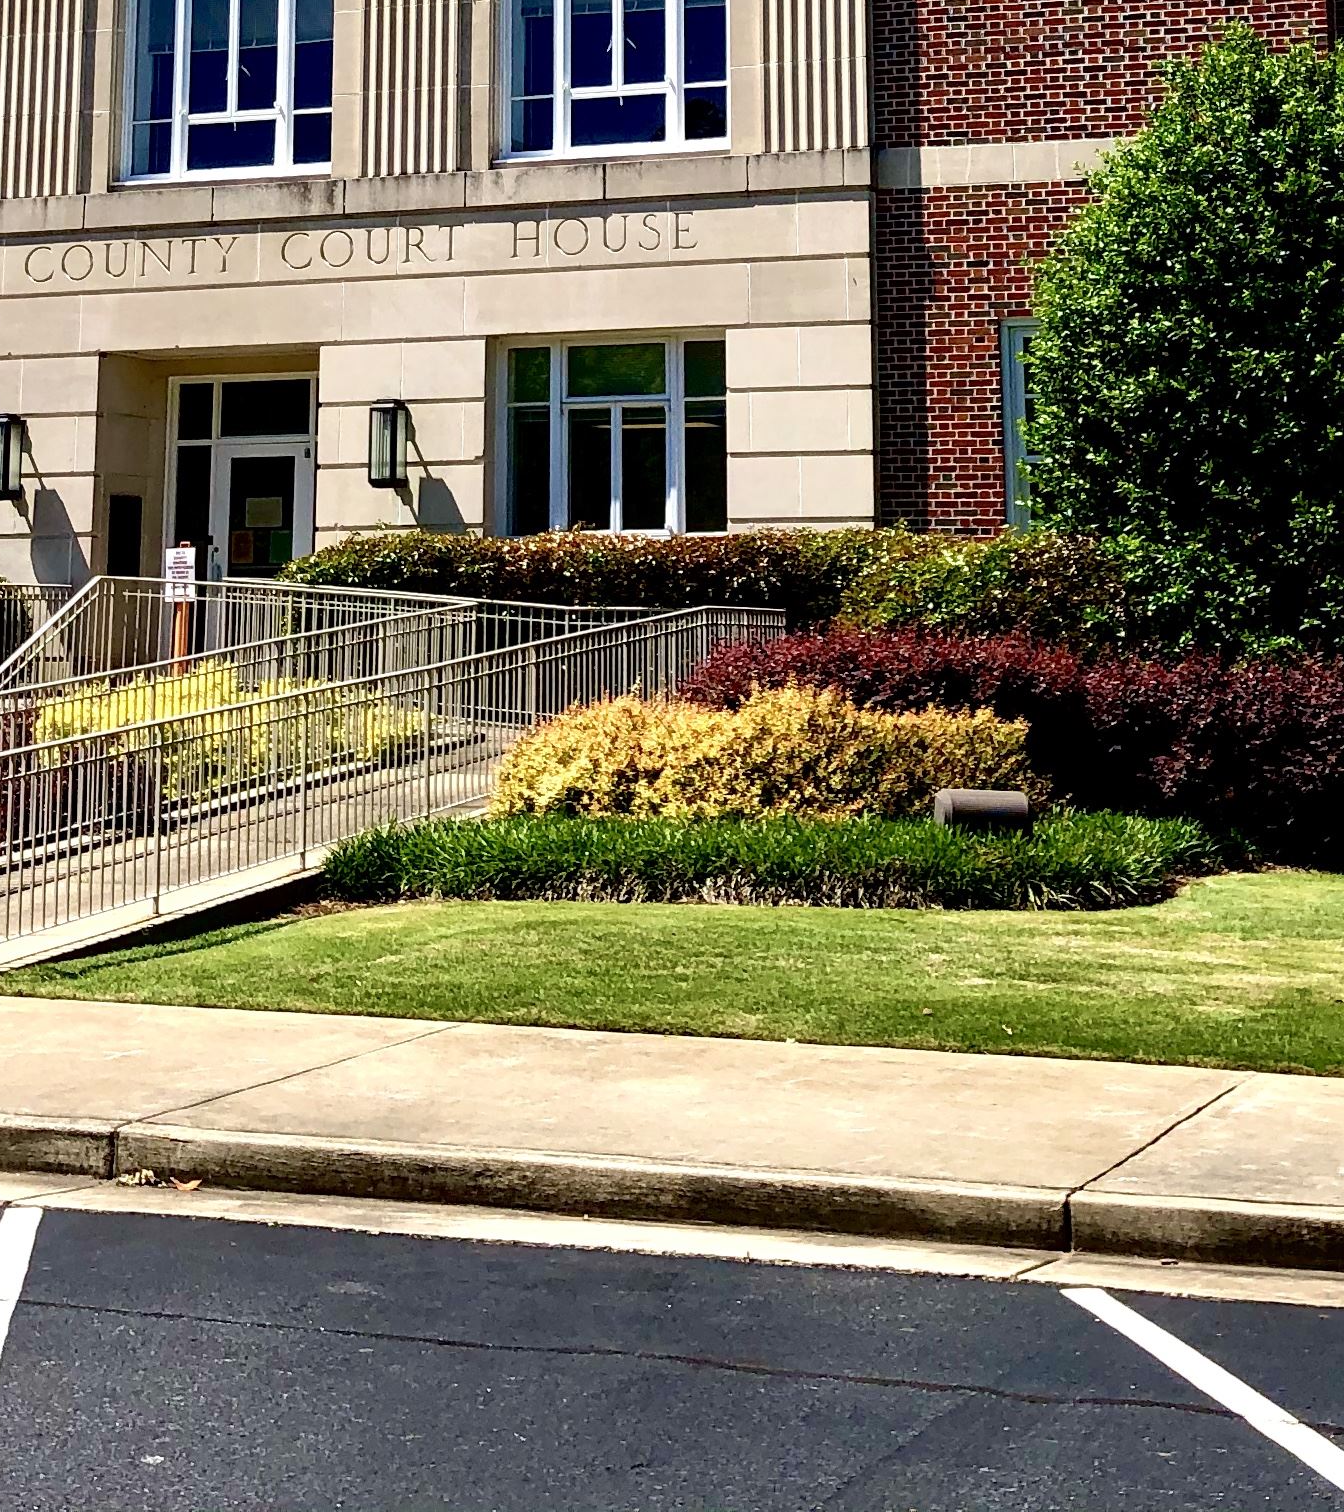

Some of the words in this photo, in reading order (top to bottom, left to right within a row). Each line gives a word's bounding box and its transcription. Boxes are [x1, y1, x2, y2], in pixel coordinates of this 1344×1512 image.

[24, 236, 240, 283] COUNTY
[281, 224, 465, 269] COURT
[509, 211, 698, 258] HOUSE
